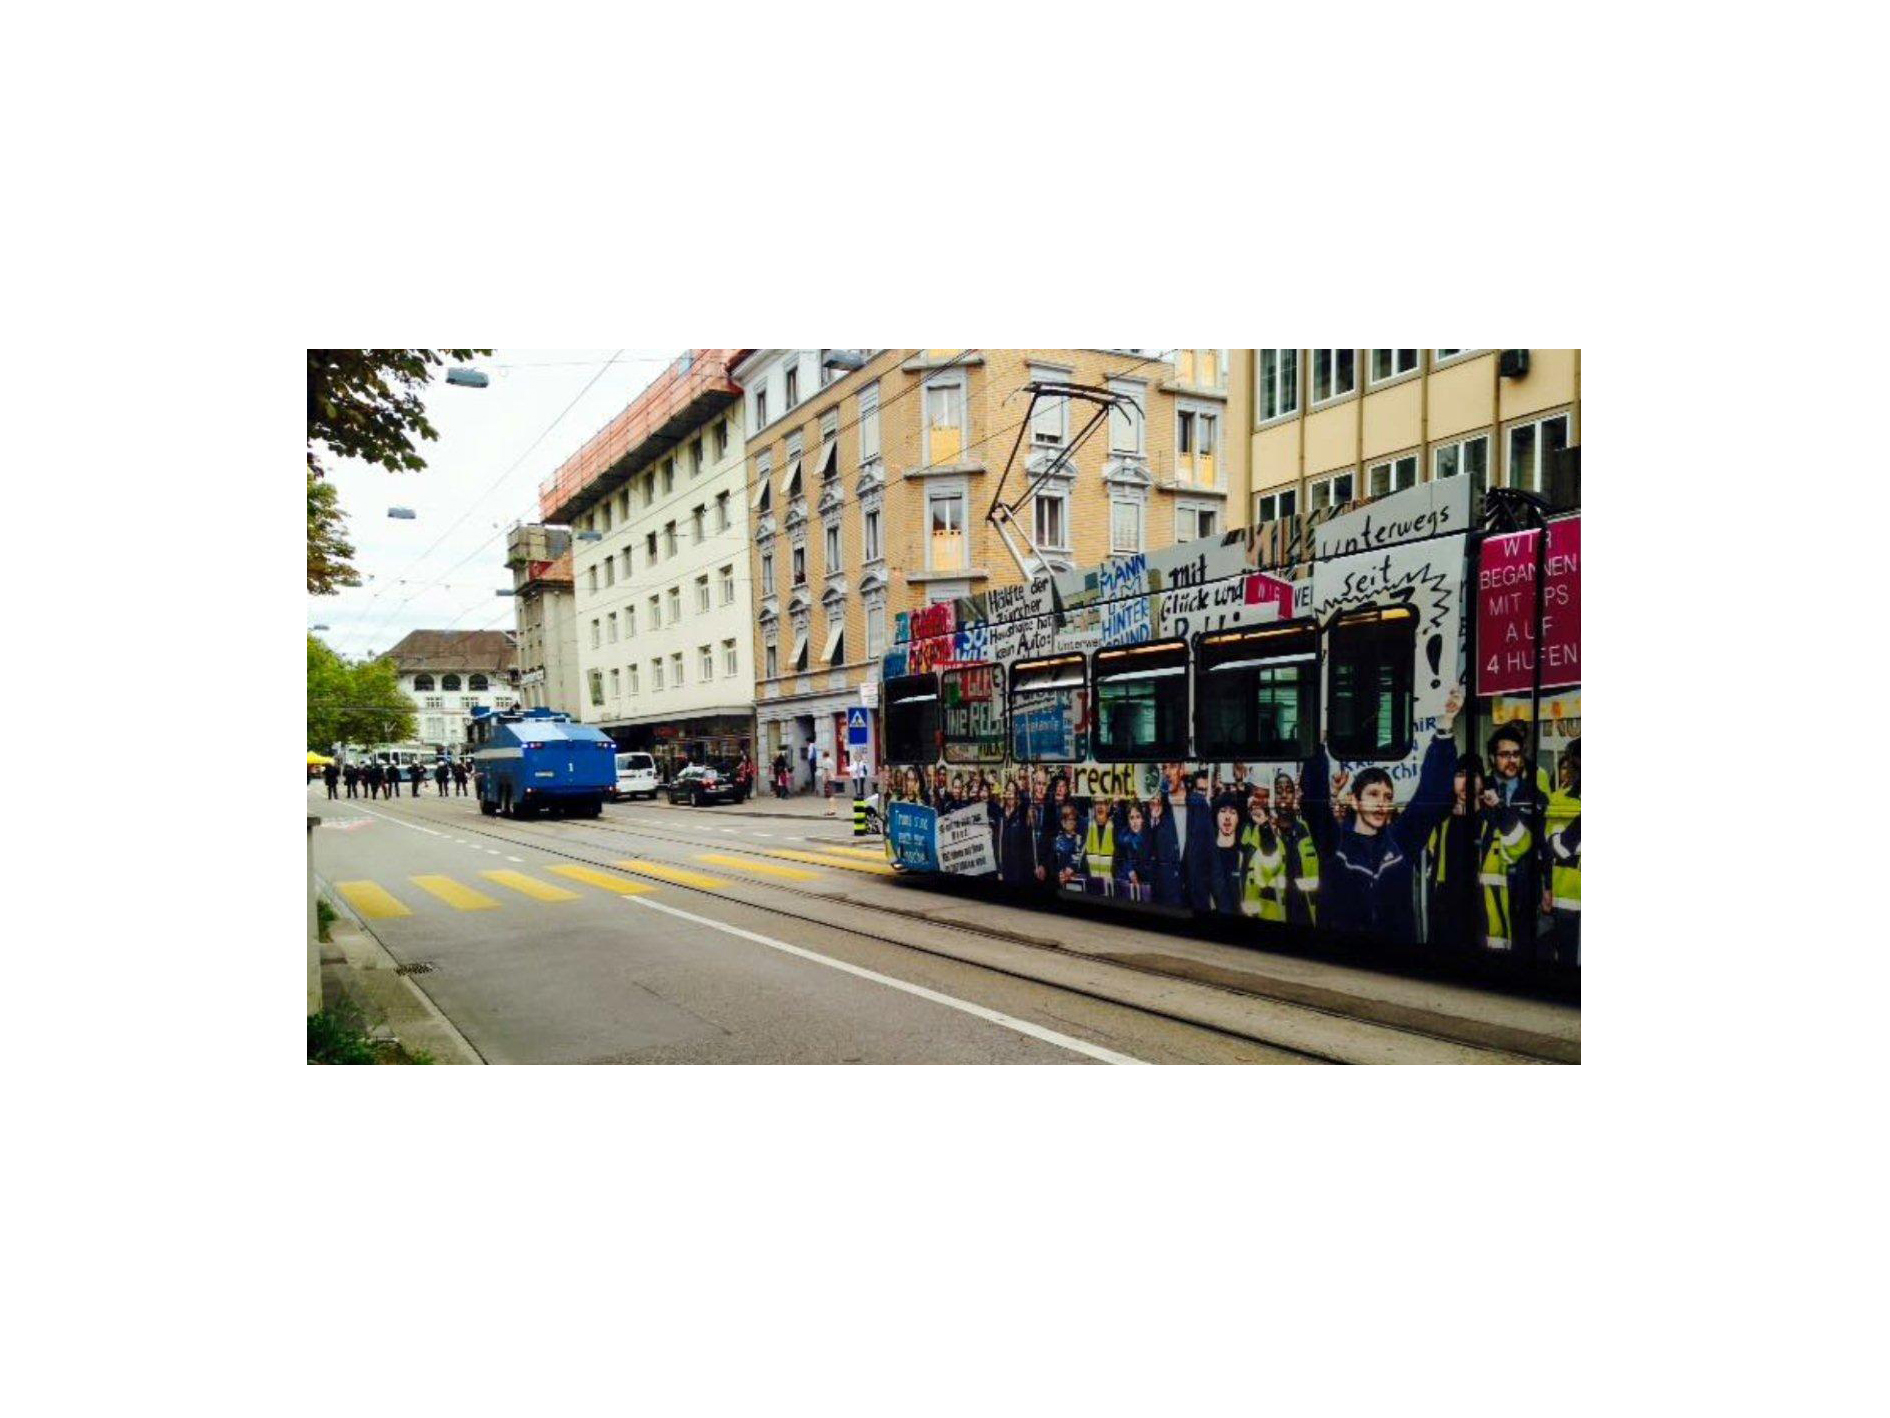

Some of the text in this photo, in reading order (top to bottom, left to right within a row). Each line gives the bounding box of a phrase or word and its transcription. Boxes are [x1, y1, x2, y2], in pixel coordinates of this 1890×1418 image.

[1341, 554, 1391, 597] seit
[1160, 587, 1209, 623] Glück
[1489, 592, 1522, 616] MIT
[1487, 654, 1499, 674] 4
